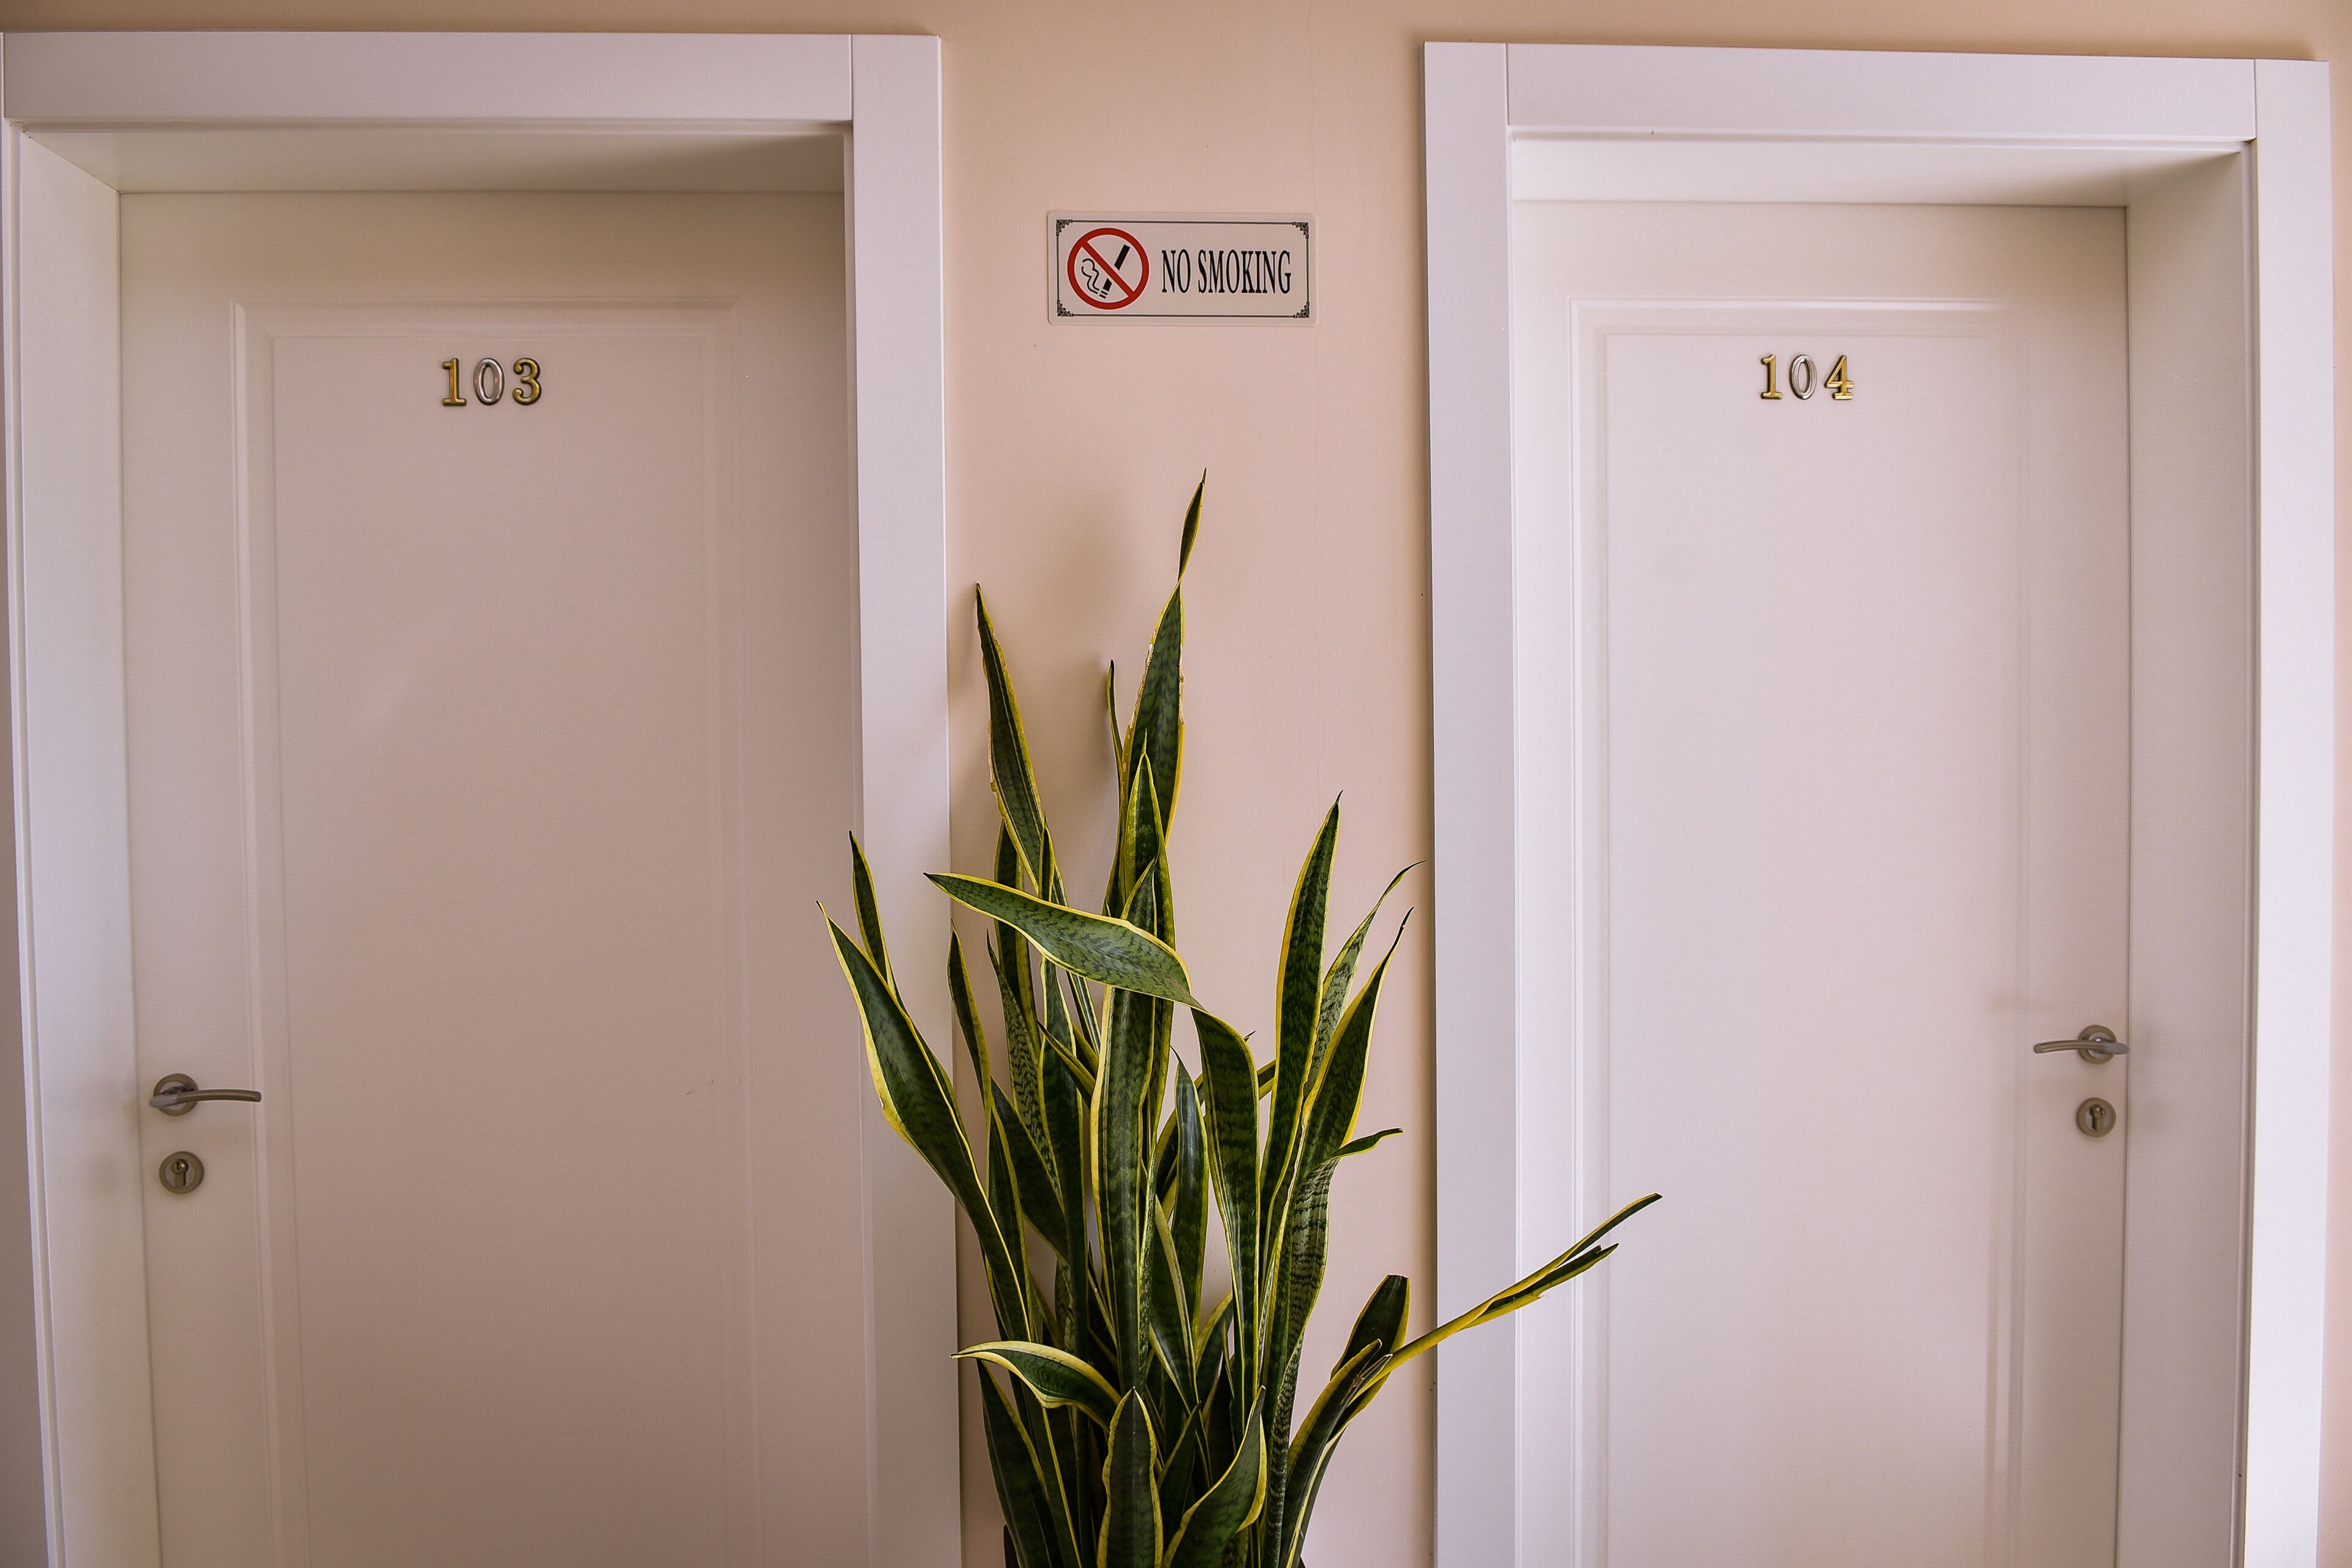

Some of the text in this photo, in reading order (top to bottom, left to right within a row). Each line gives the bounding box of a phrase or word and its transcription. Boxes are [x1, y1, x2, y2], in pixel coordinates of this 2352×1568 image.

[1161, 249, 1292, 294] NO SMOKING
[441, 357, 542, 406] 103
[1760, 353, 1855, 400] 104
